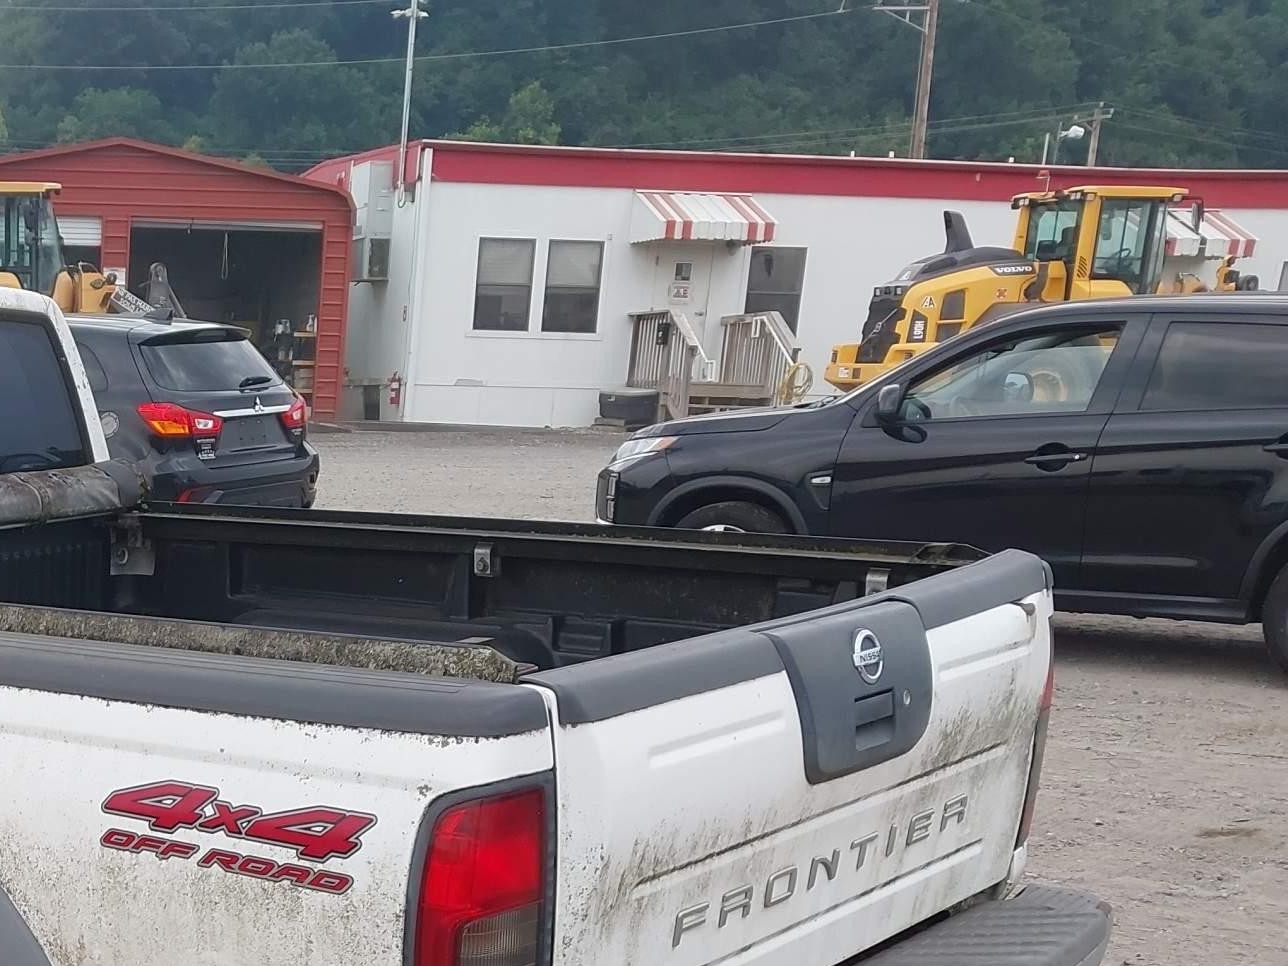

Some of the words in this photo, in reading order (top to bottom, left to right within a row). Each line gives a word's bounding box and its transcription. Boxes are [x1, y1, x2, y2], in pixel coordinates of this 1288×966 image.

[913, 320, 925, 339] L90H
[100, 828, 200, 860] OFF
[198, 848, 355, 895] ROAD
[672, 792, 969, 948] FRONTIER
